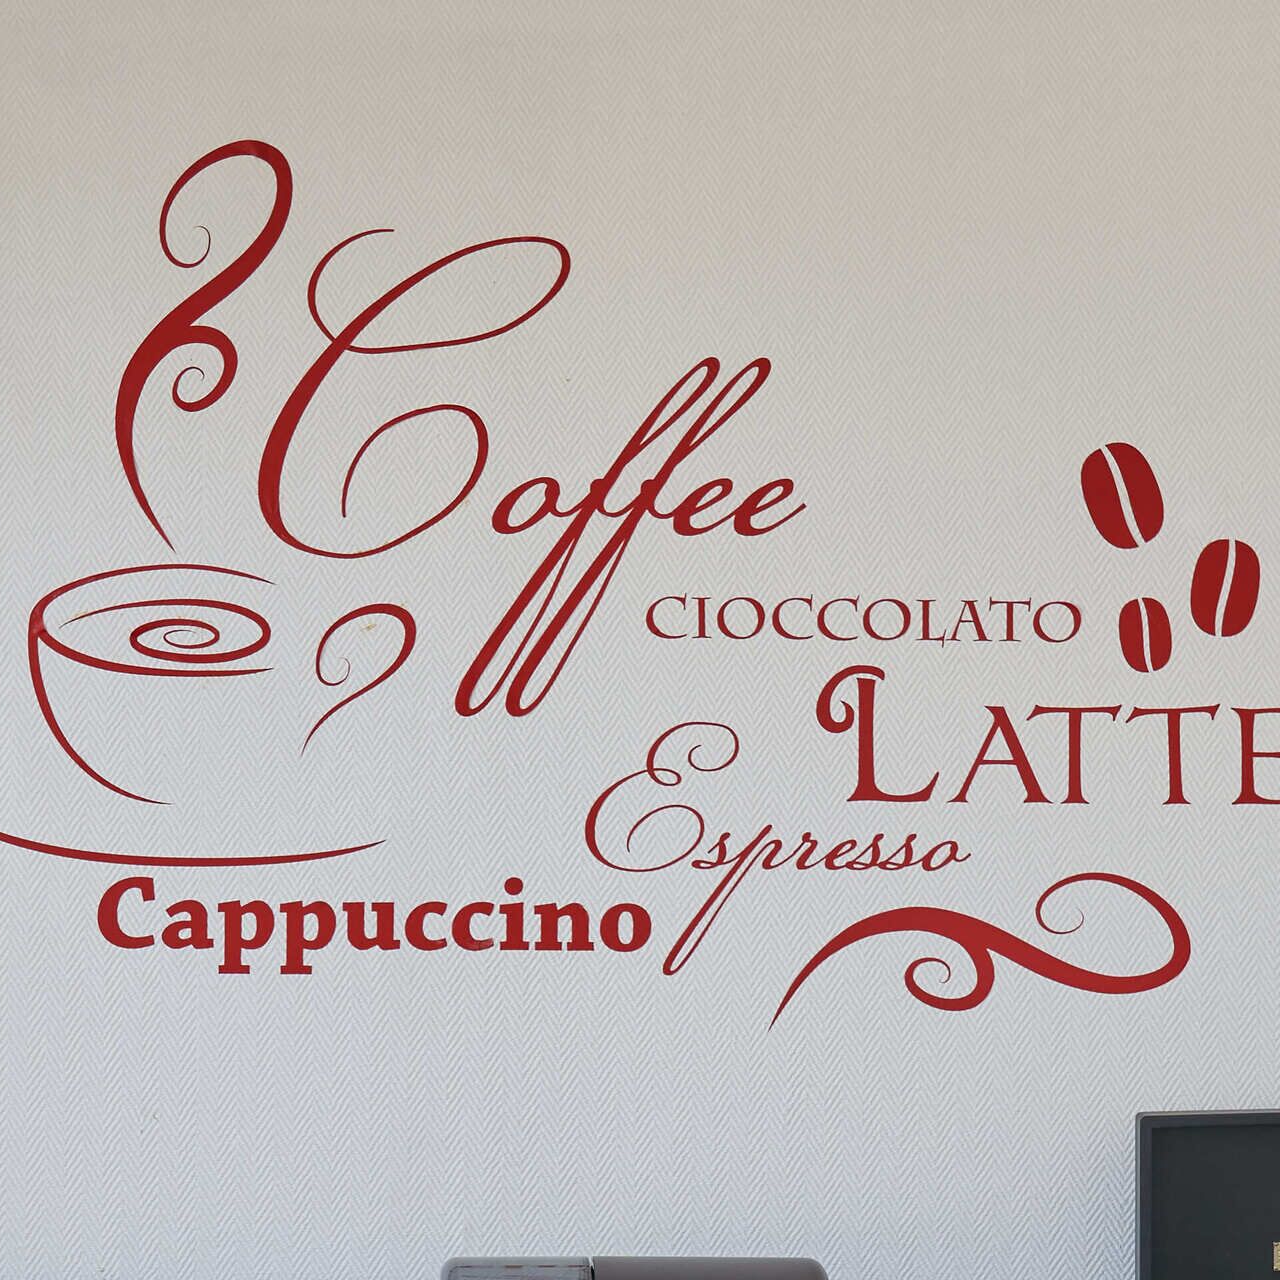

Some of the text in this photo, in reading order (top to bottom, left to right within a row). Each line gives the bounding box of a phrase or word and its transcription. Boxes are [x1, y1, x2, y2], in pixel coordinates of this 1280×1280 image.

[257, 227, 806, 719] Coffee
[645, 596, 1083, 643] CIOCCOLATO
[97, 876, 653, 975] Cappuccino
[584, 720, 973, 976] Espresso
